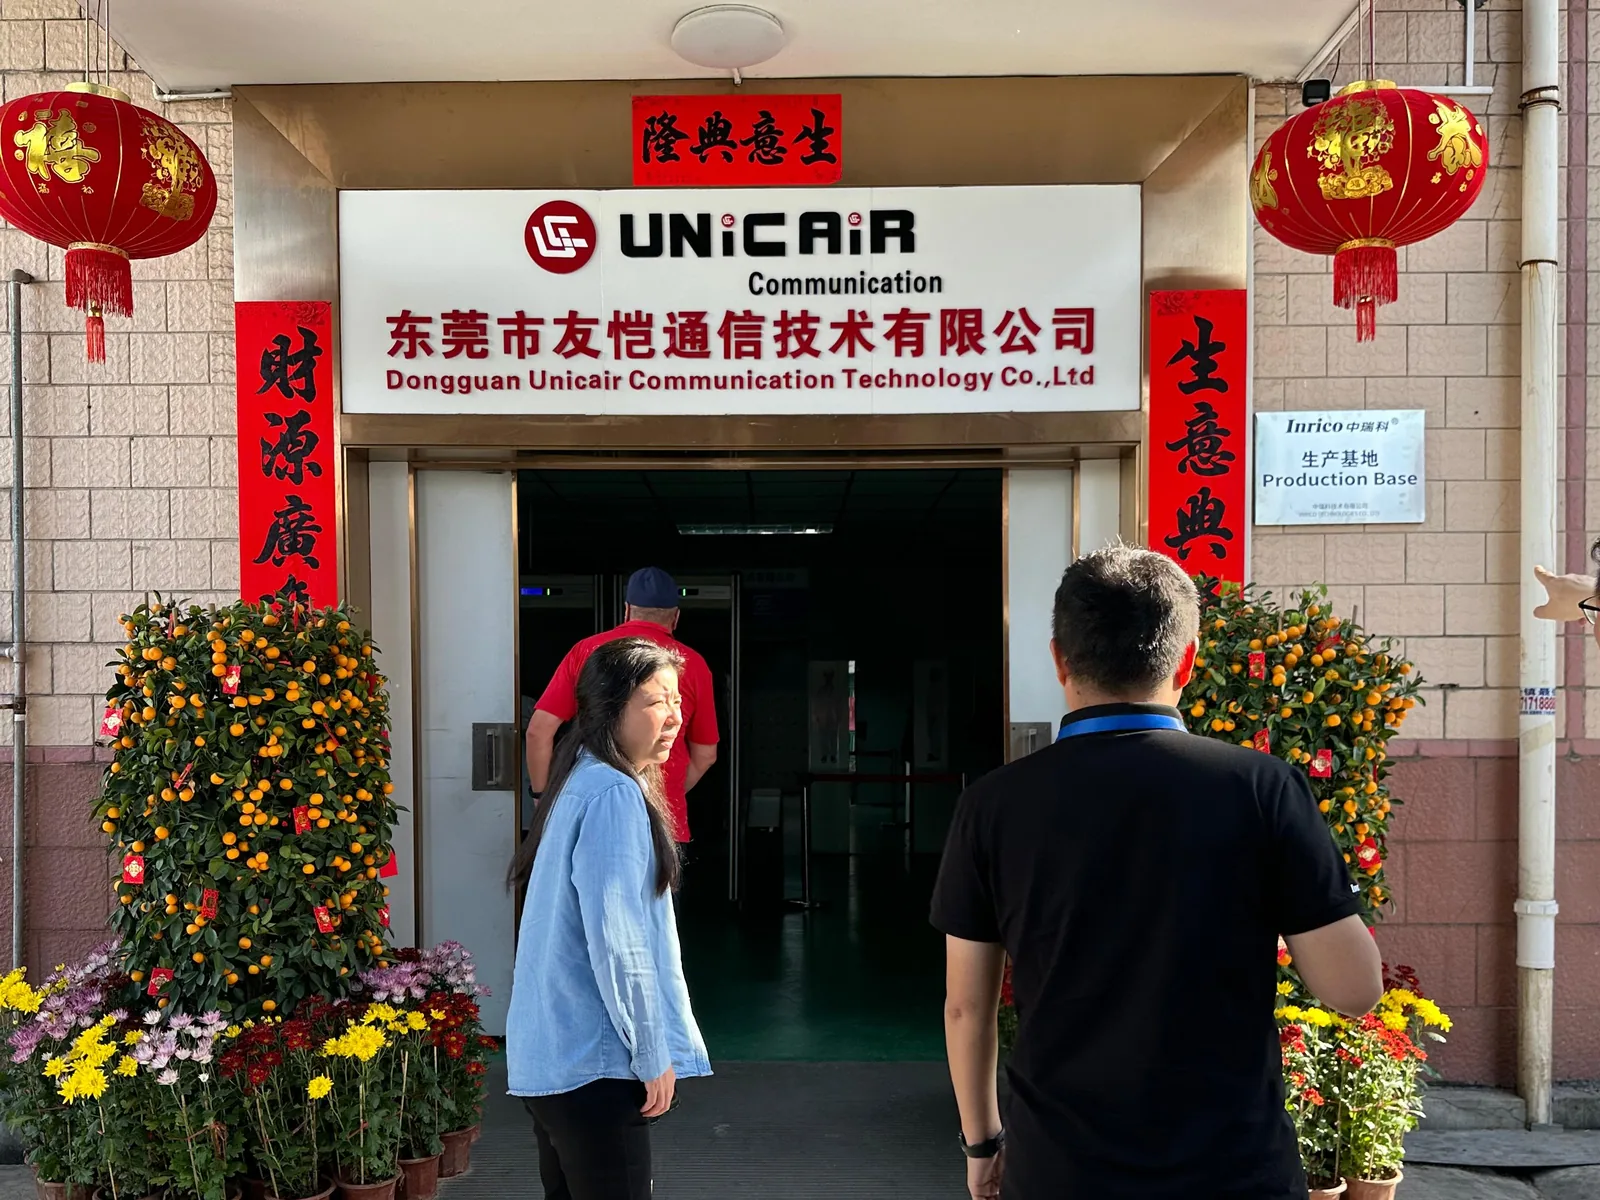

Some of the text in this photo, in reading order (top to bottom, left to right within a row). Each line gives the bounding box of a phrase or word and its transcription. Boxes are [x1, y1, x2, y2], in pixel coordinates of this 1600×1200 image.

[749, 270, 943, 295] Communication
[386, 307, 1096, 360] 东莞市友恺通信技术有限公司
[386, 365, 1095, 394] Dongguan Unicair Communication Technology Co.,Ltd
[1286, 418, 1343, 433] Inrico
[1302, 449, 1379, 468] 生产基地
[1263, 472, 1418, 487] Production Base
